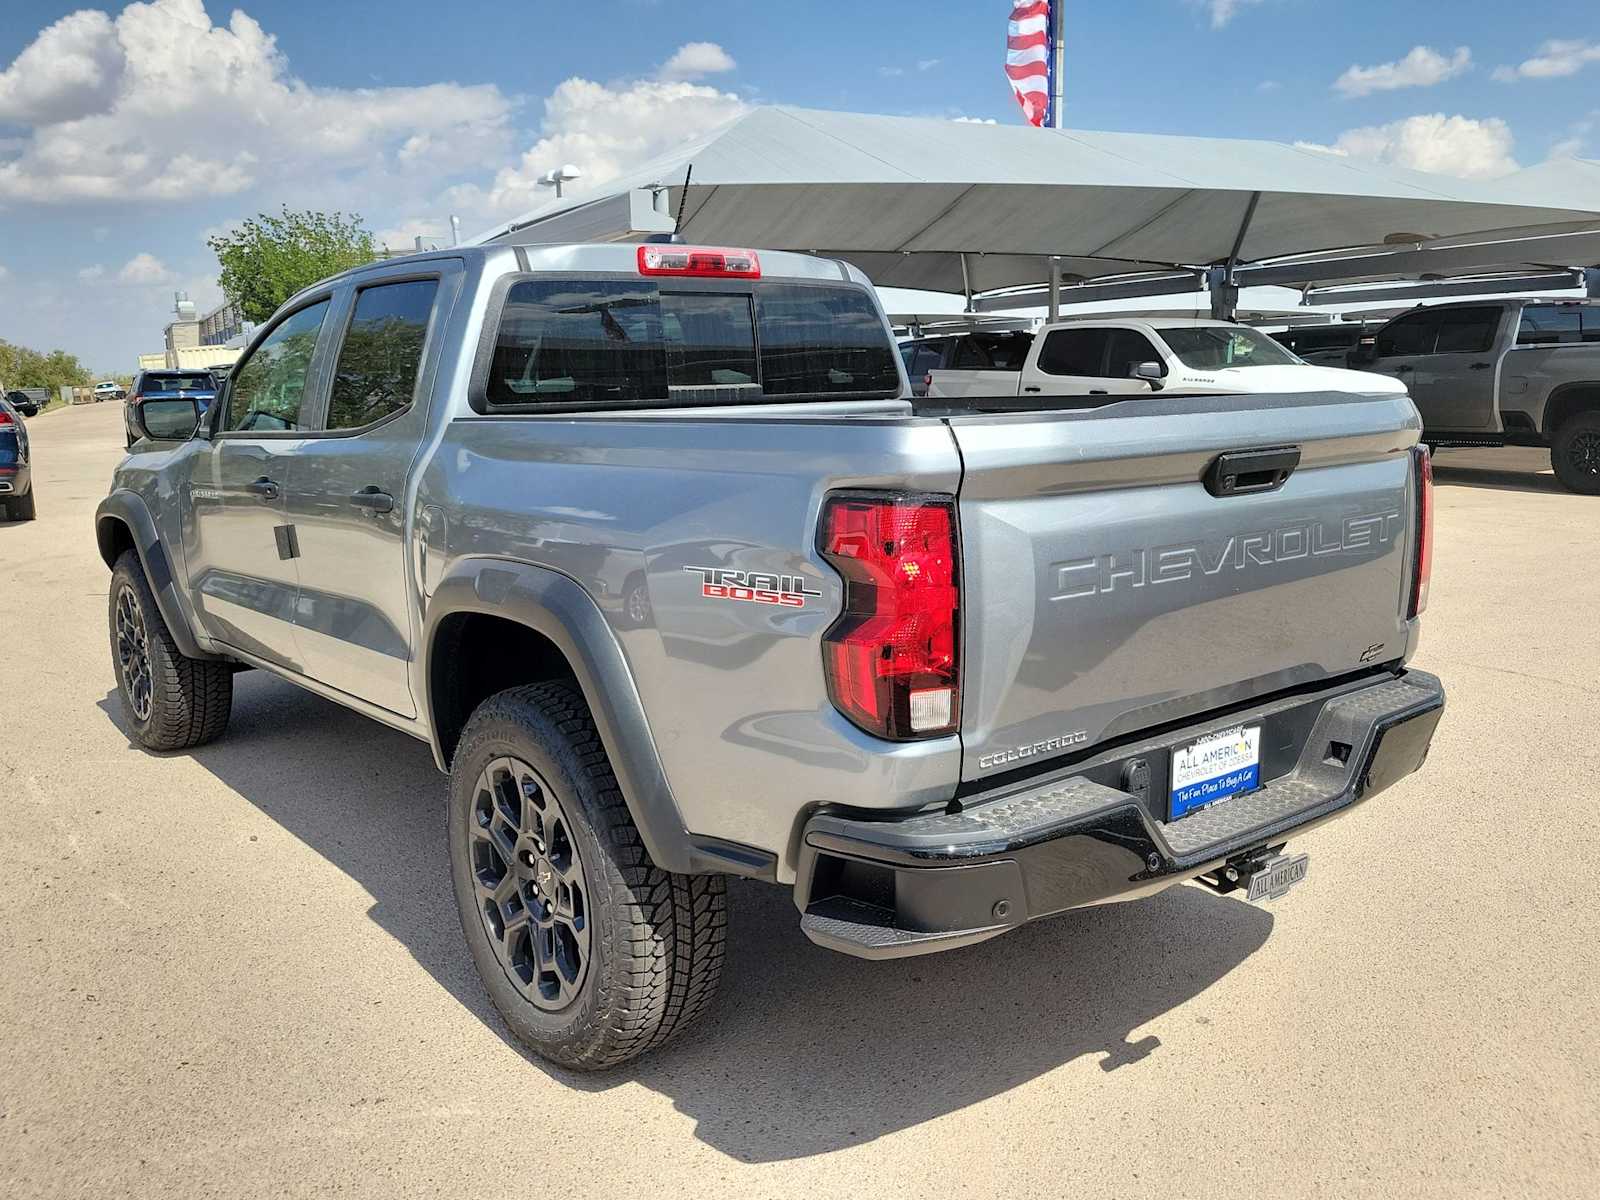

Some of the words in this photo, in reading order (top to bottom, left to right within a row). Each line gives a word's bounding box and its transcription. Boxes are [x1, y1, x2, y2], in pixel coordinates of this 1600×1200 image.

[1049, 511, 1399, 602] CHEVROLET
[683, 565, 823, 598] TRAIL
[702, 583, 805, 608] BOSS
[979, 730, 1089, 769] COLORADO
[1180, 754, 1198, 772] ALL
[1178, 789, 1188, 803] The
